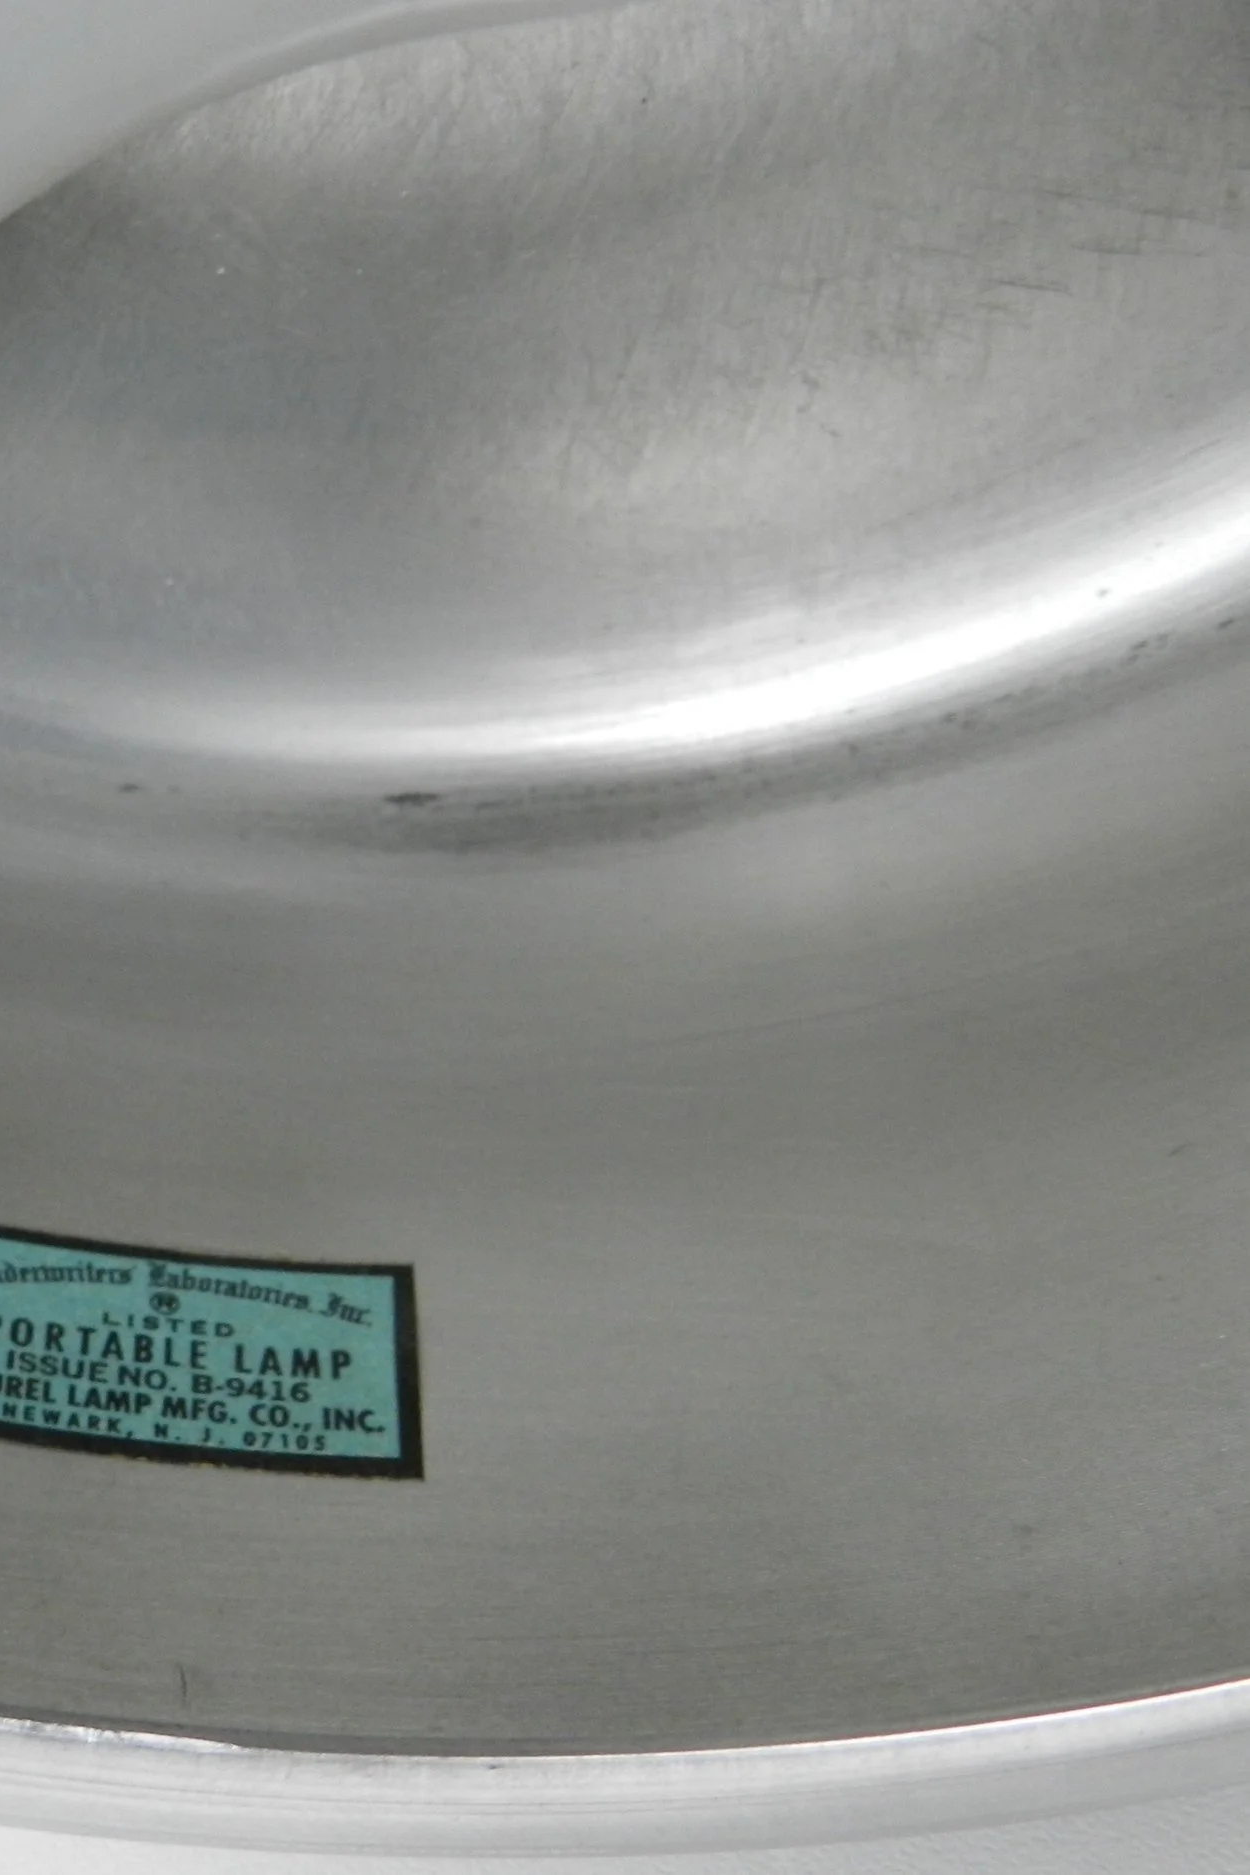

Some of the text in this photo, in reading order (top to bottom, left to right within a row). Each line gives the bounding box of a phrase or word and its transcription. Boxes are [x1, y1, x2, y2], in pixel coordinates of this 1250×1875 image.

[102, 1310, 236, 1338] LISTED
[5, 1349, 312, 1403] ISSUE NO. B-9416
[233, 1343, 352, 1382] LAMP
[1, 1401, 327, 1452] NEWARK, N. J. 07105
[67, 1383, 152, 1415] LAMP
[160, 1396, 238, 1425] MFG.
[249, 1403, 312, 1433] CO.,
[321, 1406, 386, 1434] INC.
